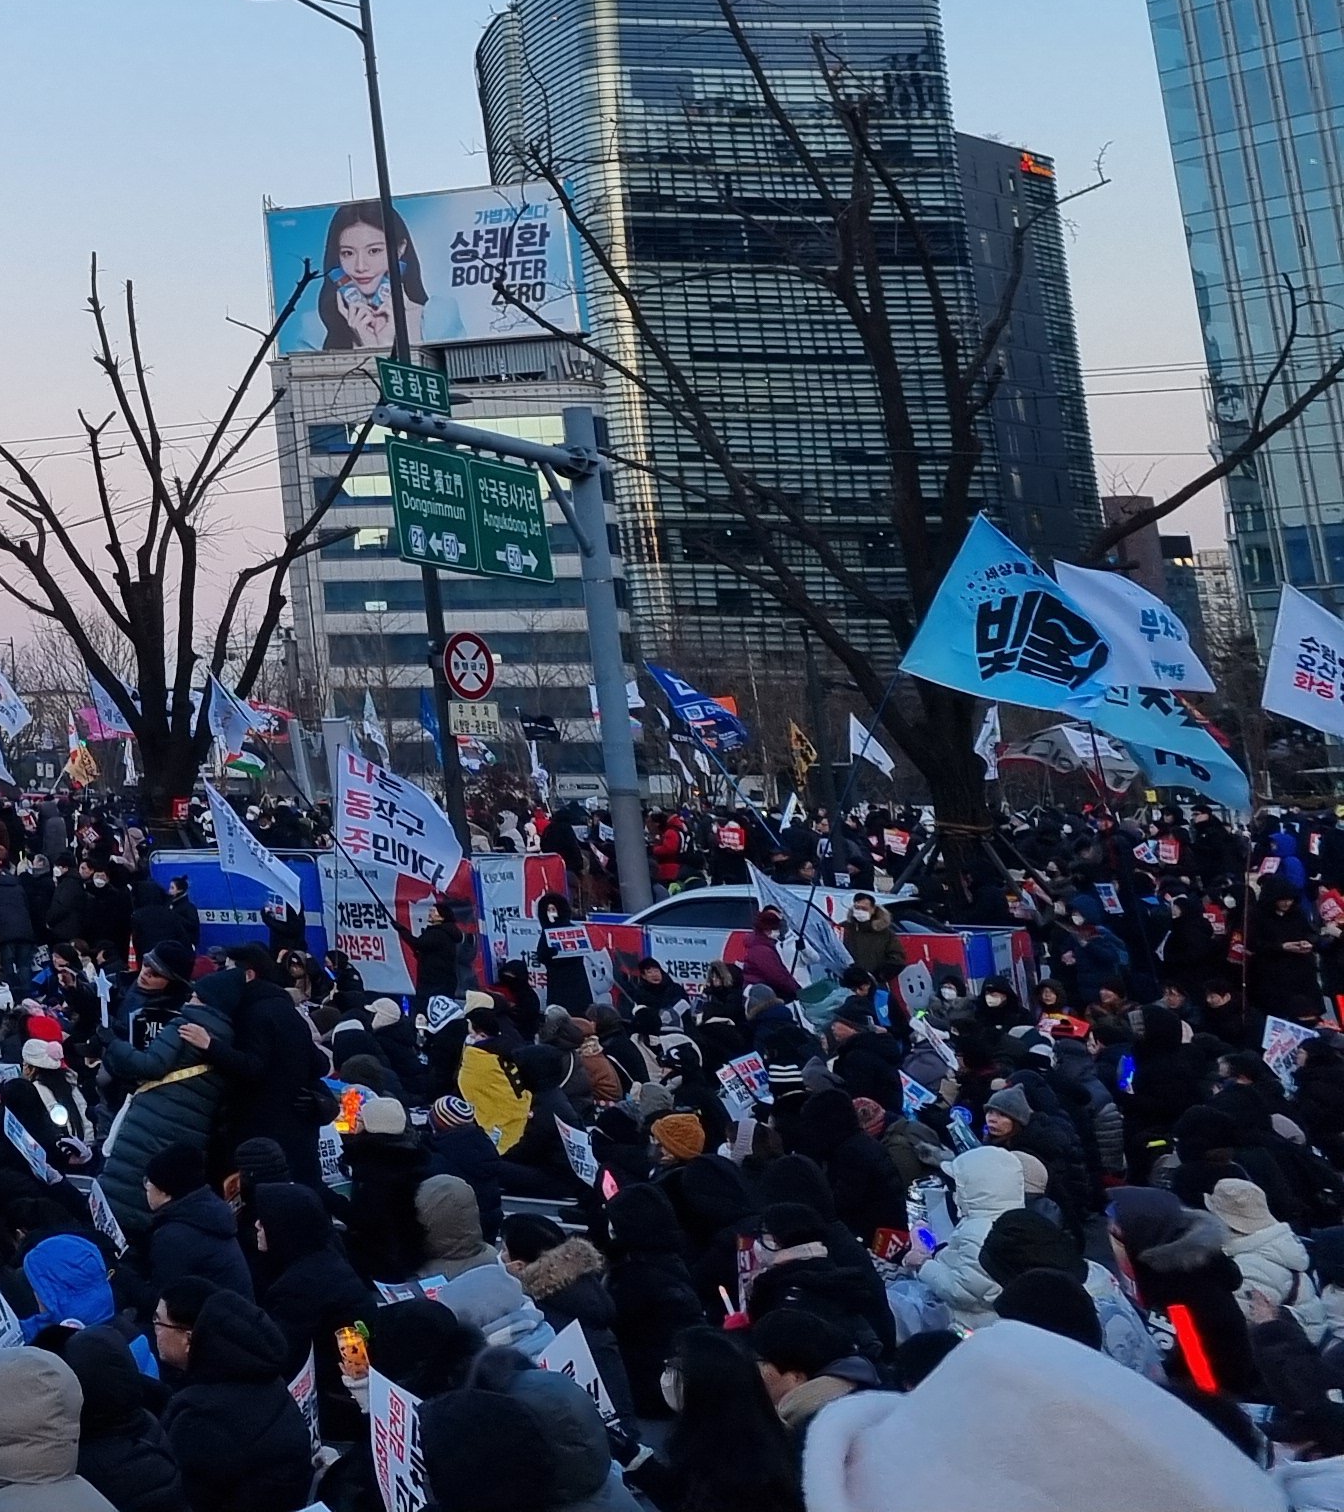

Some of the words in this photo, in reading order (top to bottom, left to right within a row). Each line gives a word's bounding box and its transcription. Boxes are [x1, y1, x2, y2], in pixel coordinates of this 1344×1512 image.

[450, 223, 550, 263] 상쾌환
[452, 258, 547, 287] BOOSTER
[492, 281, 546, 306] ZERO
[388, 369, 441, 407] 광화문
[398, 457, 431, 492] 독립문
[401, 491, 466, 521] Dongnimmun
[478, 477, 539, 515] 안국동사거리
[412, 531, 426, 551] 21
[444, 537, 457, 557] 50
[508, 550, 521, 568] 50
[347, 754, 404, 800] 나는
[344, 789, 426, 838] 동작구
[342, 826, 445, 889] 주민이다
[206, 911, 230, 922] 안전
[338, 902, 389, 930] 차량주변
[337, 934, 386, 962] 안전주의
